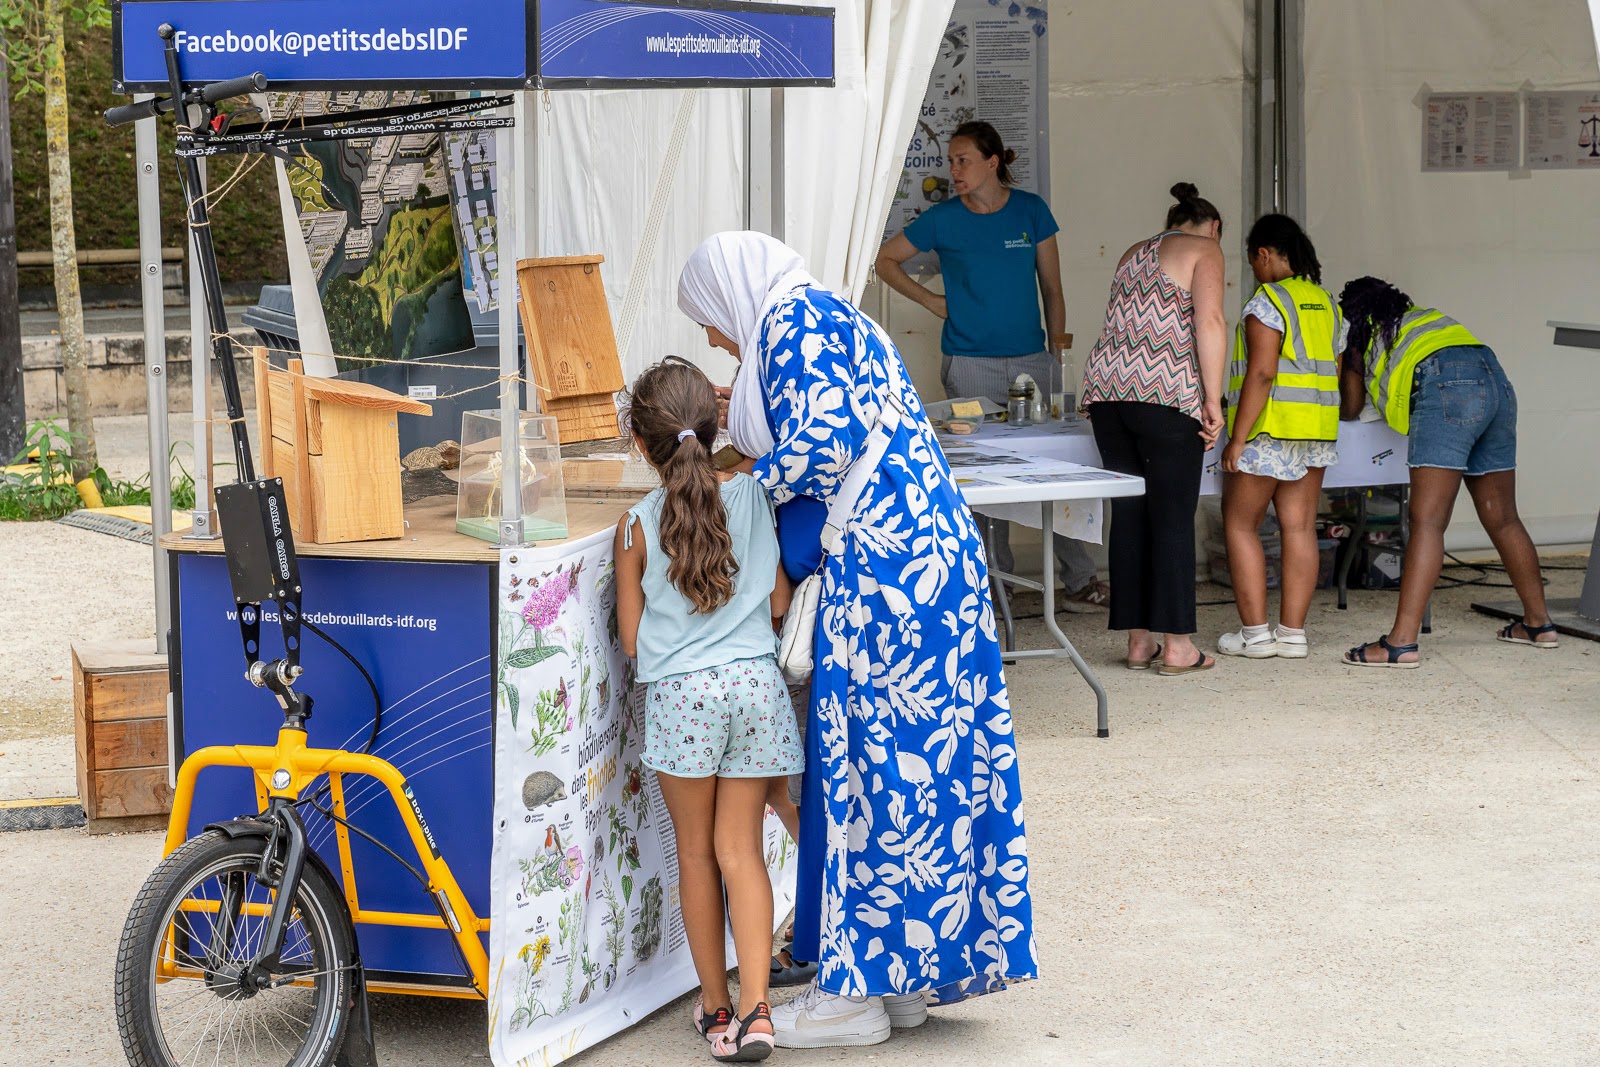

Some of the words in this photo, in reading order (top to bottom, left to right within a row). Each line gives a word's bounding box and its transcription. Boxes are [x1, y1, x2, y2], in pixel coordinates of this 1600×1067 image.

[174, 27, 468, 56] Facebook@petitsdebsIDF
[646, 33, 761, 57] www.lespetitsdebrouillards-idf.org
[389, 99, 500, 125] www.carlacargo.de
[450, 118, 515, 130] #carisover
[323, 122, 435, 136] www.carlacargo.de
[268, 496, 282, 536] CARLA
[276, 538, 290, 580] CARGO
[578, 715, 619, 770] biodiversité
[586, 723, 592, 742] La
[572, 772, 586, 795] dans
[587, 753, 617, 805] friches
[580, 792, 588, 812] les
